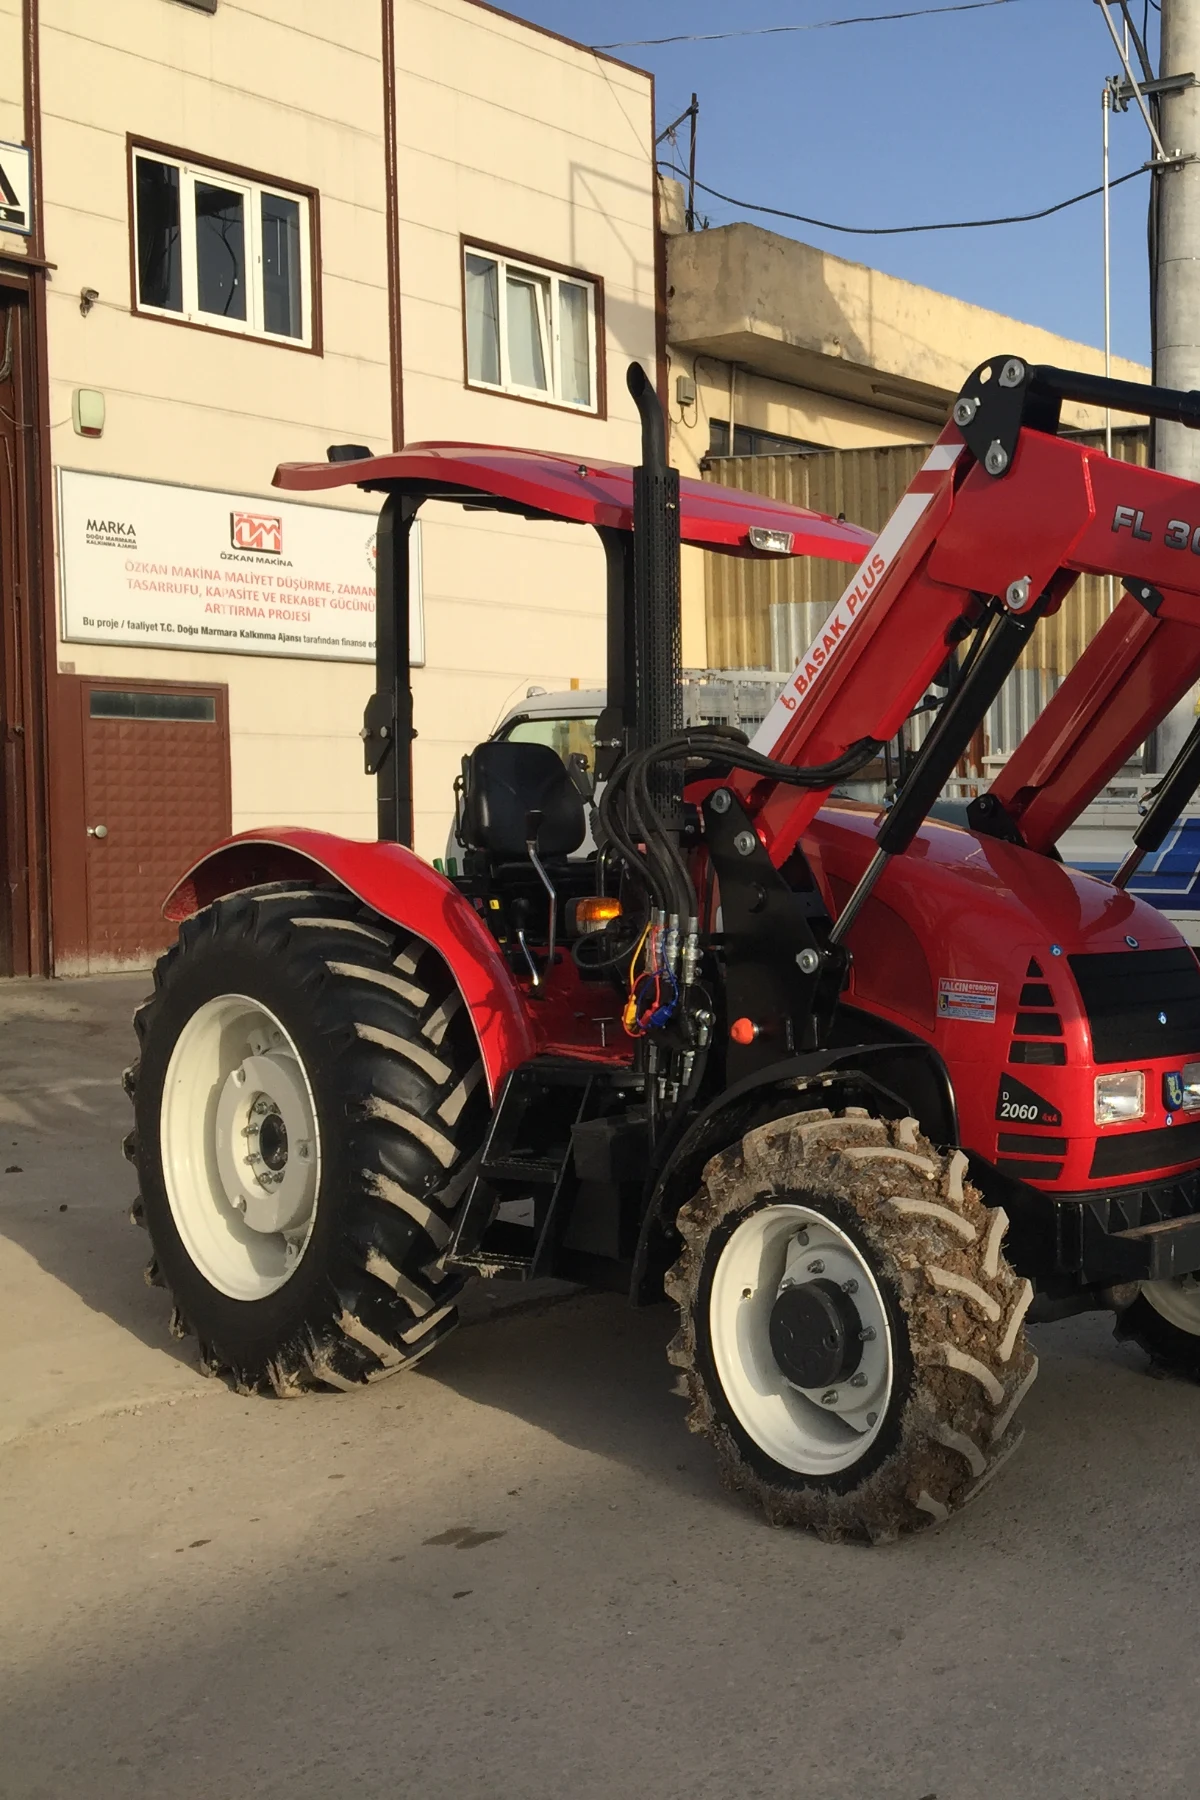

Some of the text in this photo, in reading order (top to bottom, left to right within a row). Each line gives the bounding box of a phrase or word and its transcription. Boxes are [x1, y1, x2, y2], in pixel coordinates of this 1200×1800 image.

[86, 518, 137, 536] MARKA
[1111, 504, 1152, 542] FL
[220, 551, 293, 568] ÖZKAN MAKİNA
[124, 557, 168, 576] ÖZKAN
[171, 565, 222, 581] MAKİNA
[224, 571, 274, 587] MALİYET
[337, 583, 377, 598] ZAMAN
[845, 553, 886, 616] PLUS
[126, 578, 376, 613] TASARRUFU, KAPASİTE VE REKABET GÜCÜNÜ
[204, 602, 311, 622] ARTTIRMA PROJESİ
[82, 616, 95, 627] Bu
[96, 619, 119, 629] proje
[127, 620, 159, 632] faaliyet
[159, 622, 175, 633] T.C.
[177, 624, 199, 636] Doğu
[200, 626, 238, 638] Marmara
[239, 629, 276, 641] Kalkınma
[278, 632, 302, 643] Ajansı
[303, 635, 340, 646] tarafından
[341, 638, 367, 648] finanse
[1002, 1091, 1010, 1101] D
[1000, 1102, 1039, 1120] 2060
